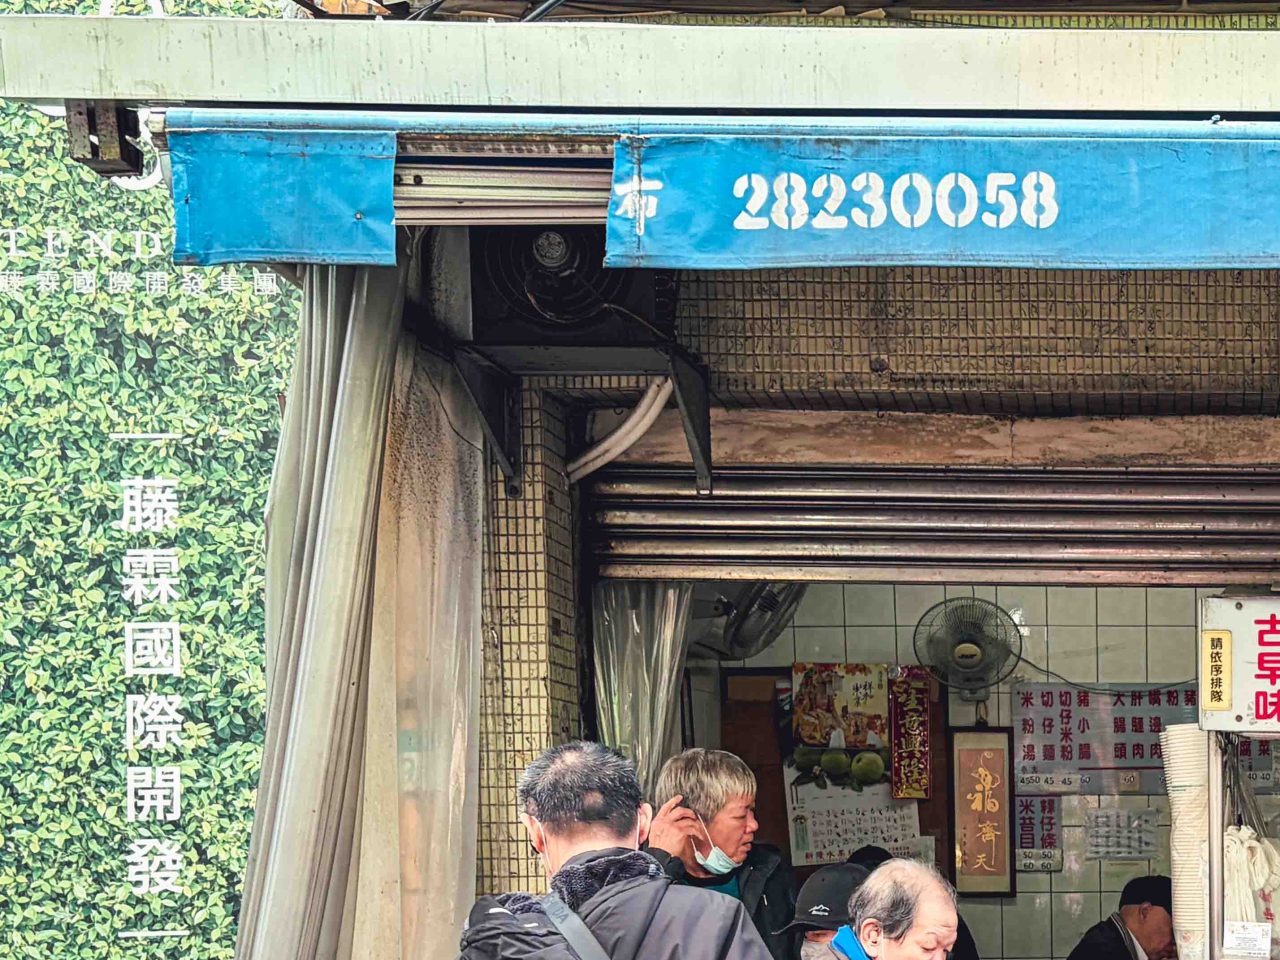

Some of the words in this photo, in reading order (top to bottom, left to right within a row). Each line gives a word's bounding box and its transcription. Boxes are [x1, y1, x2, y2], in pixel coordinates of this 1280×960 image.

[733, 171, 1059, 230] 28230058
[118, 475, 184, 896] 藤霖國際開發
[1210, 637, 1224, 704] 請依序排隊
[1020, 691, 1036, 762] 米粉湯
[1058, 690, 1073, 761] 切仔米粉
[1112, 691, 1128, 760] 大腸頭
[1044, 776, 1055, 785] 45
[1061, 777, 1073, 786] 45
[1019, 798, 1035, 849] 米苔目
[1023, 851, 1033, 859] 50
[1041, 851, 1053, 859] 50
[1023, 862, 1034, 870] 60
[1041, 862, 1052, 870] 60
